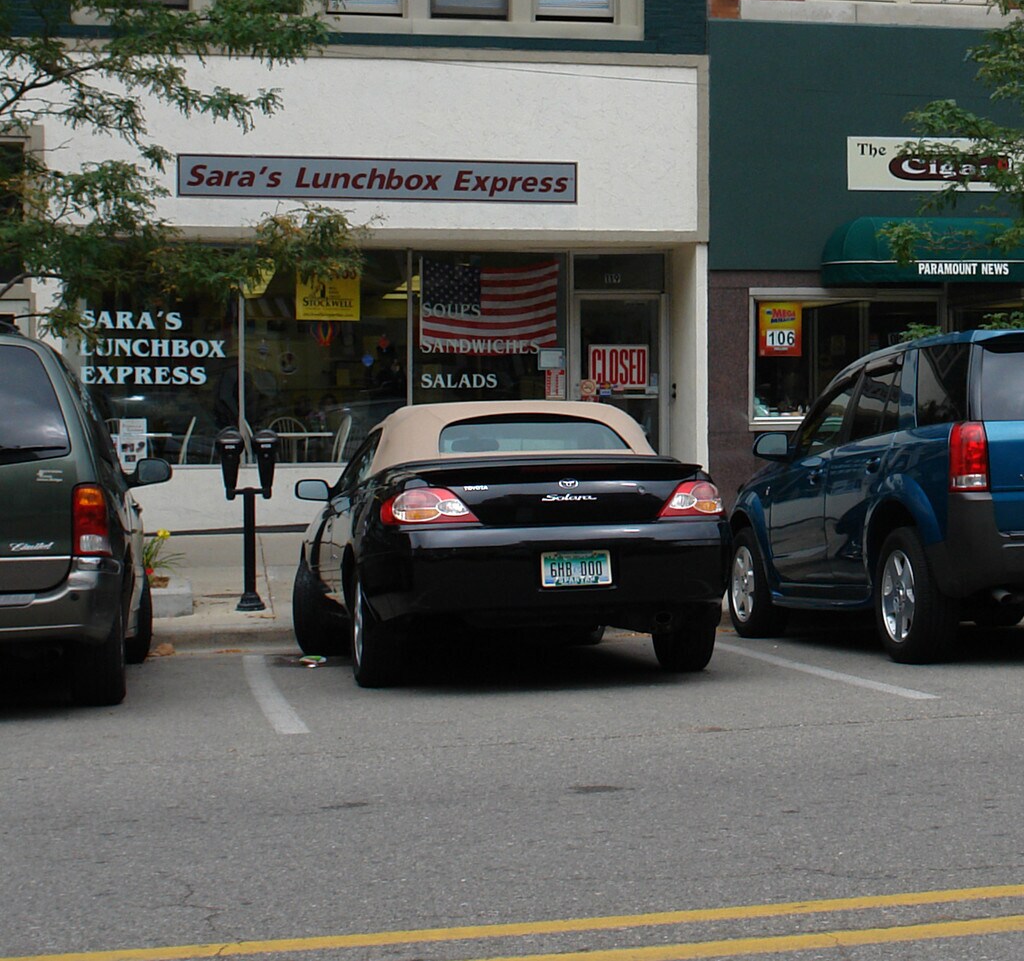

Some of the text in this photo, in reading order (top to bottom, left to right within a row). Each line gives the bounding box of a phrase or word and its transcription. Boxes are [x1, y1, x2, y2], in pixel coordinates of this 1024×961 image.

[857, 143, 887, 157] The
[186, 163, 569, 197] Sara's Lunchbox Express
[918, 263, 1010, 275] PARAMOUNT NEWS
[422, 302, 481, 318] SOUPS
[79, 309, 183, 331] SARA'S
[768, 331, 796, 346] 106
[80, 338, 226, 358] LUNCHBOX
[421, 339, 540, 355] SANDWICHES
[591, 348, 647, 385] CLOSED
[80, 366, 208, 385] EXPRESS
[421, 373, 498, 389] SALADS
[541, 493, 598, 502] Solara
[550, 561, 572, 578] 6HB
